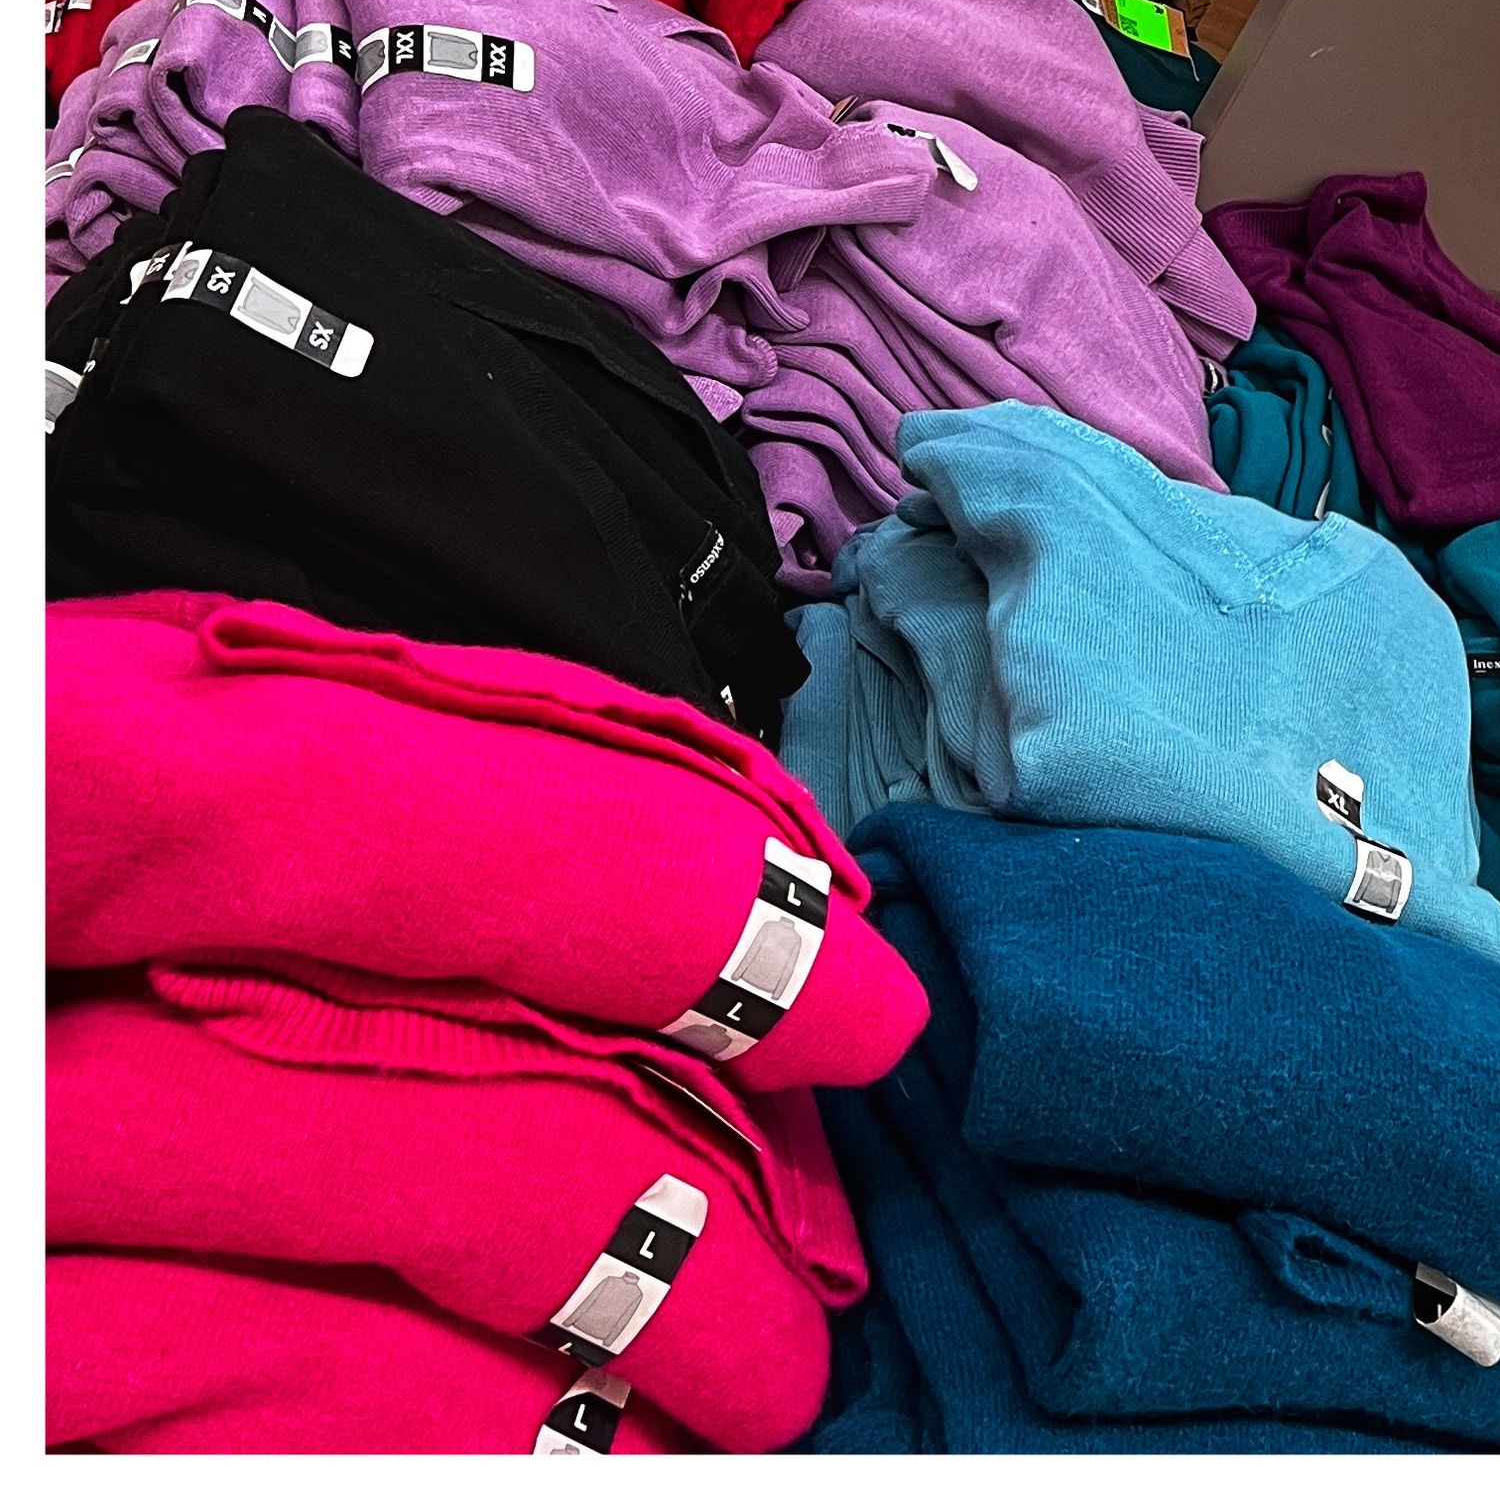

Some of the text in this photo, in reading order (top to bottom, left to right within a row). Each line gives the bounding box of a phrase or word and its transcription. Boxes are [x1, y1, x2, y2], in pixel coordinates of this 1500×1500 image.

[252, 6, 267, 24] M
[338, 40, 352, 60] M
[396, 31, 414, 65] XXL
[489, 42, 507, 77] XXL
[207, 266, 236, 295] XS
[309, 321, 334, 350] XS
[1327, 788, 1349, 815] XL
[787, 882, 801, 907] L
[726, 1002, 743, 1022] L
[639, 1231, 656, 1259] L
[573, 1403, 588, 1432] L
